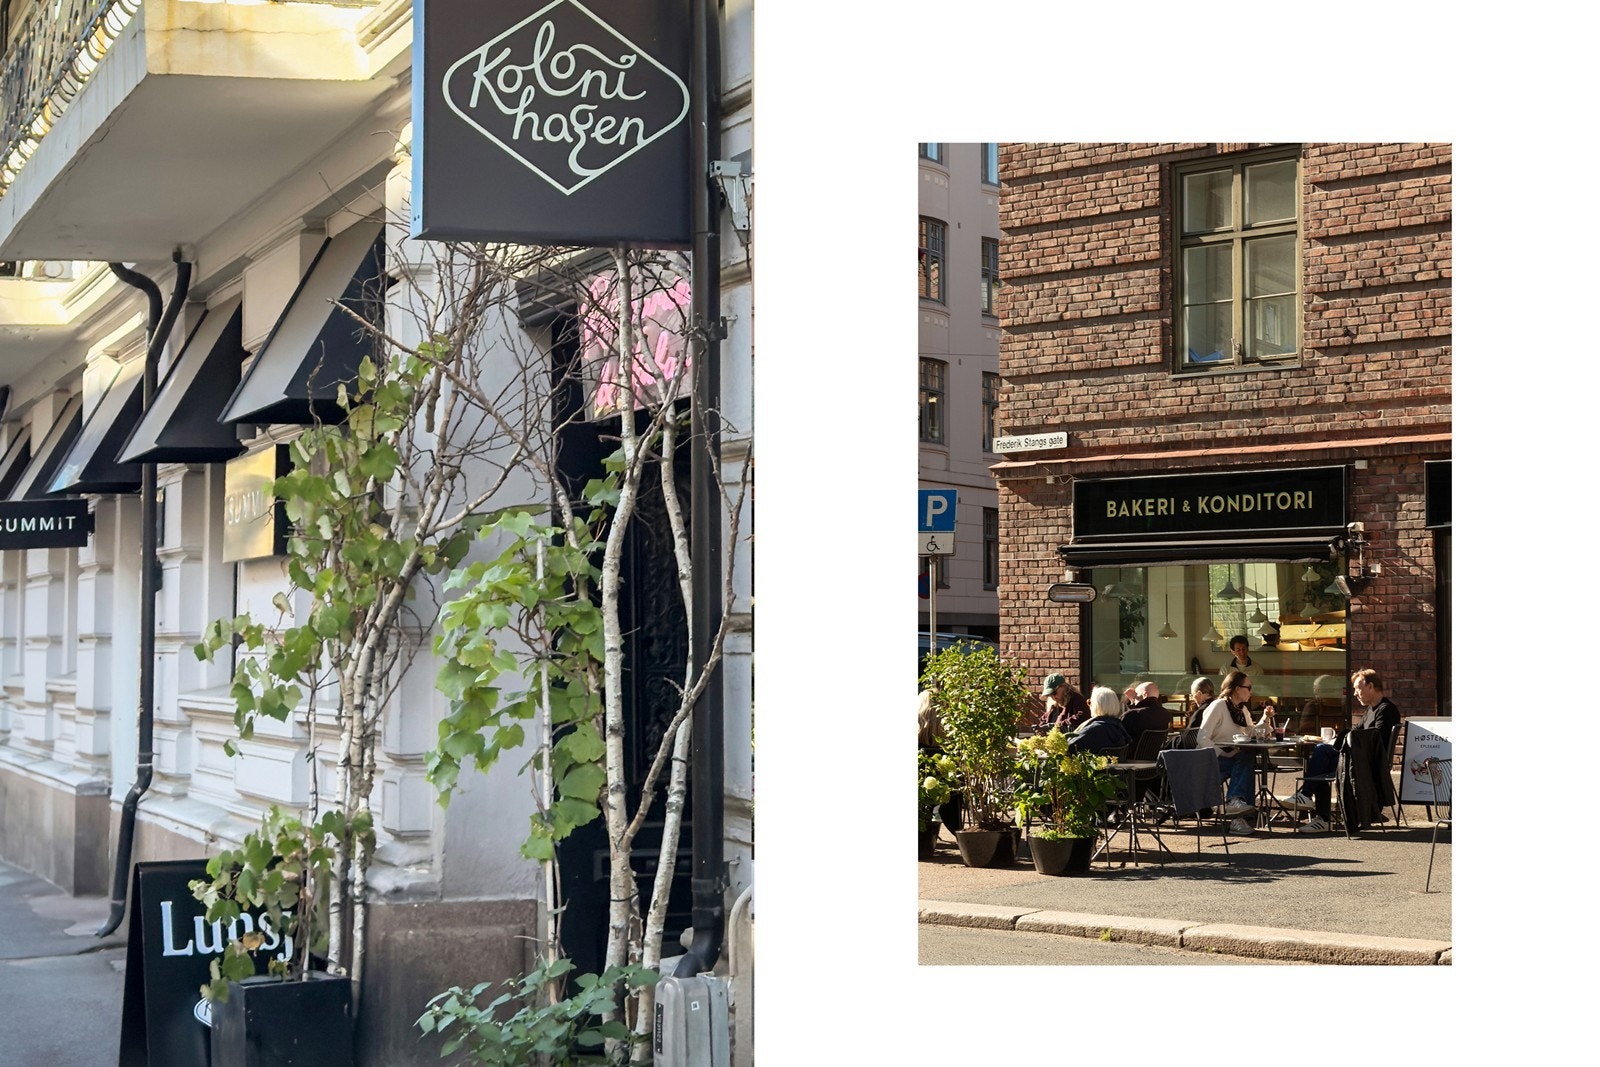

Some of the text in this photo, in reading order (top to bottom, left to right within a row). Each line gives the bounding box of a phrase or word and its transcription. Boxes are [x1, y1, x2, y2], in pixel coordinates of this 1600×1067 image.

[469, 20, 647, 108] Koloni
[512, 85, 649, 177] hagen
[996, 435, 1063, 449] Frederik Stangs gate
[925, 495, 948, 527] P
[1106, 490, 1313, 518] BAKERI & KONDITORI
[0, 515, 77, 533] UMMIT
